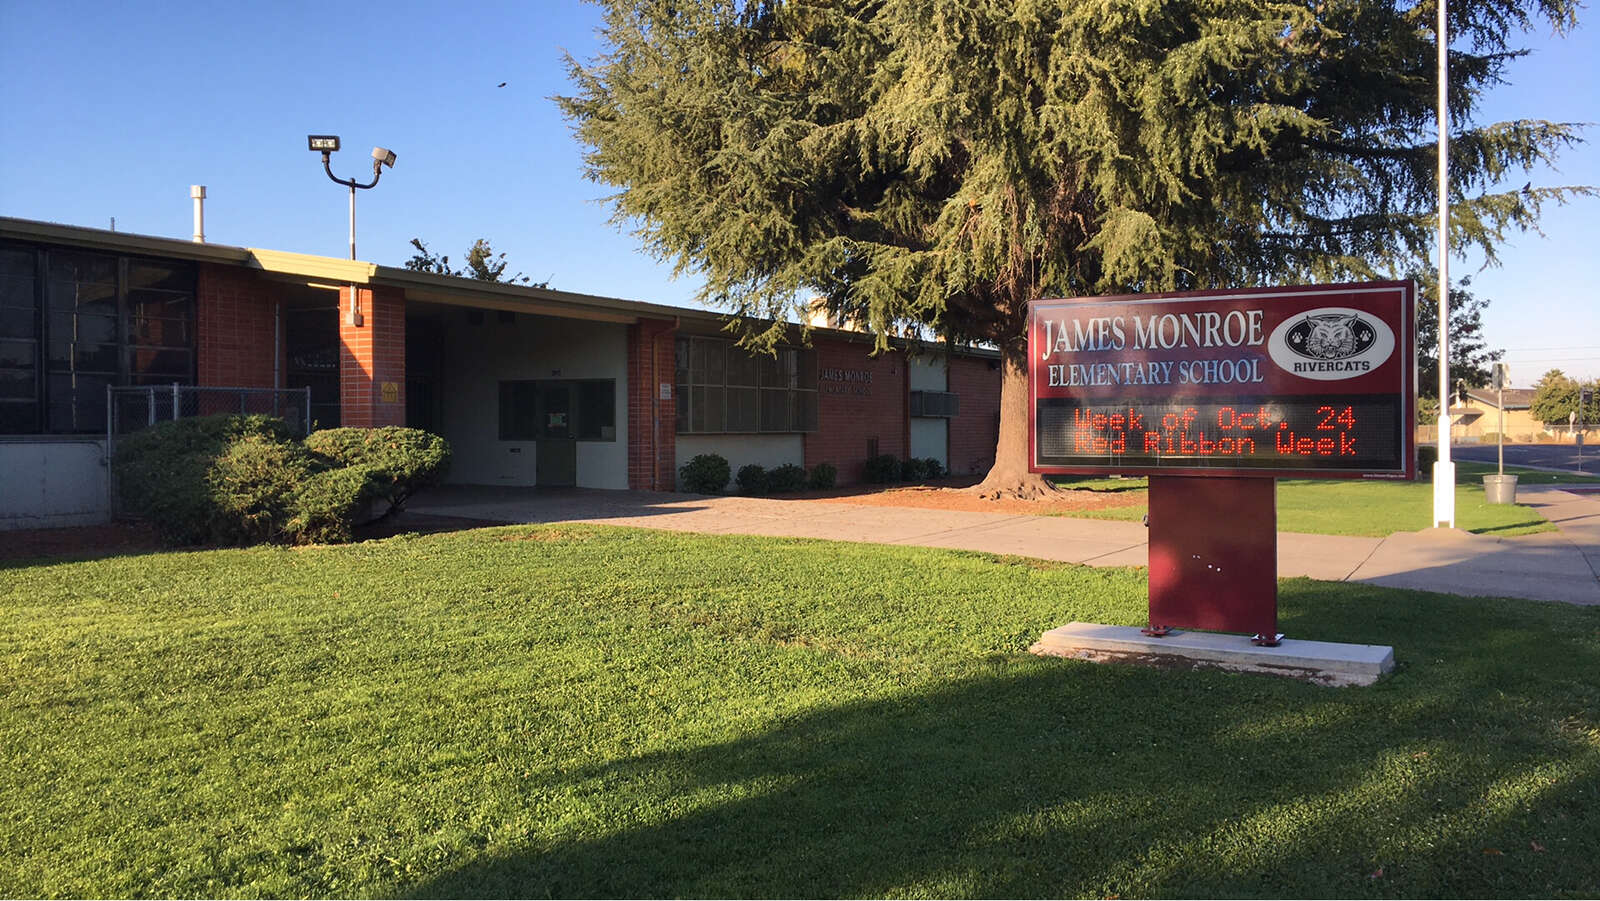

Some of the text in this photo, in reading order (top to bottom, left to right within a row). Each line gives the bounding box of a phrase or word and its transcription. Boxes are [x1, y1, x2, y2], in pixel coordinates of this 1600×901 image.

[1042, 310, 1265, 361] JAMES MONROE
[1048, 358, 1264, 387] ELEMENTARY SCHOOL
[1294, 361, 1370, 373] RIVERCATS
[1074, 406, 1357, 430] Week of Oct. 24
[1074, 431, 1357, 455] Red Ribbon Week
